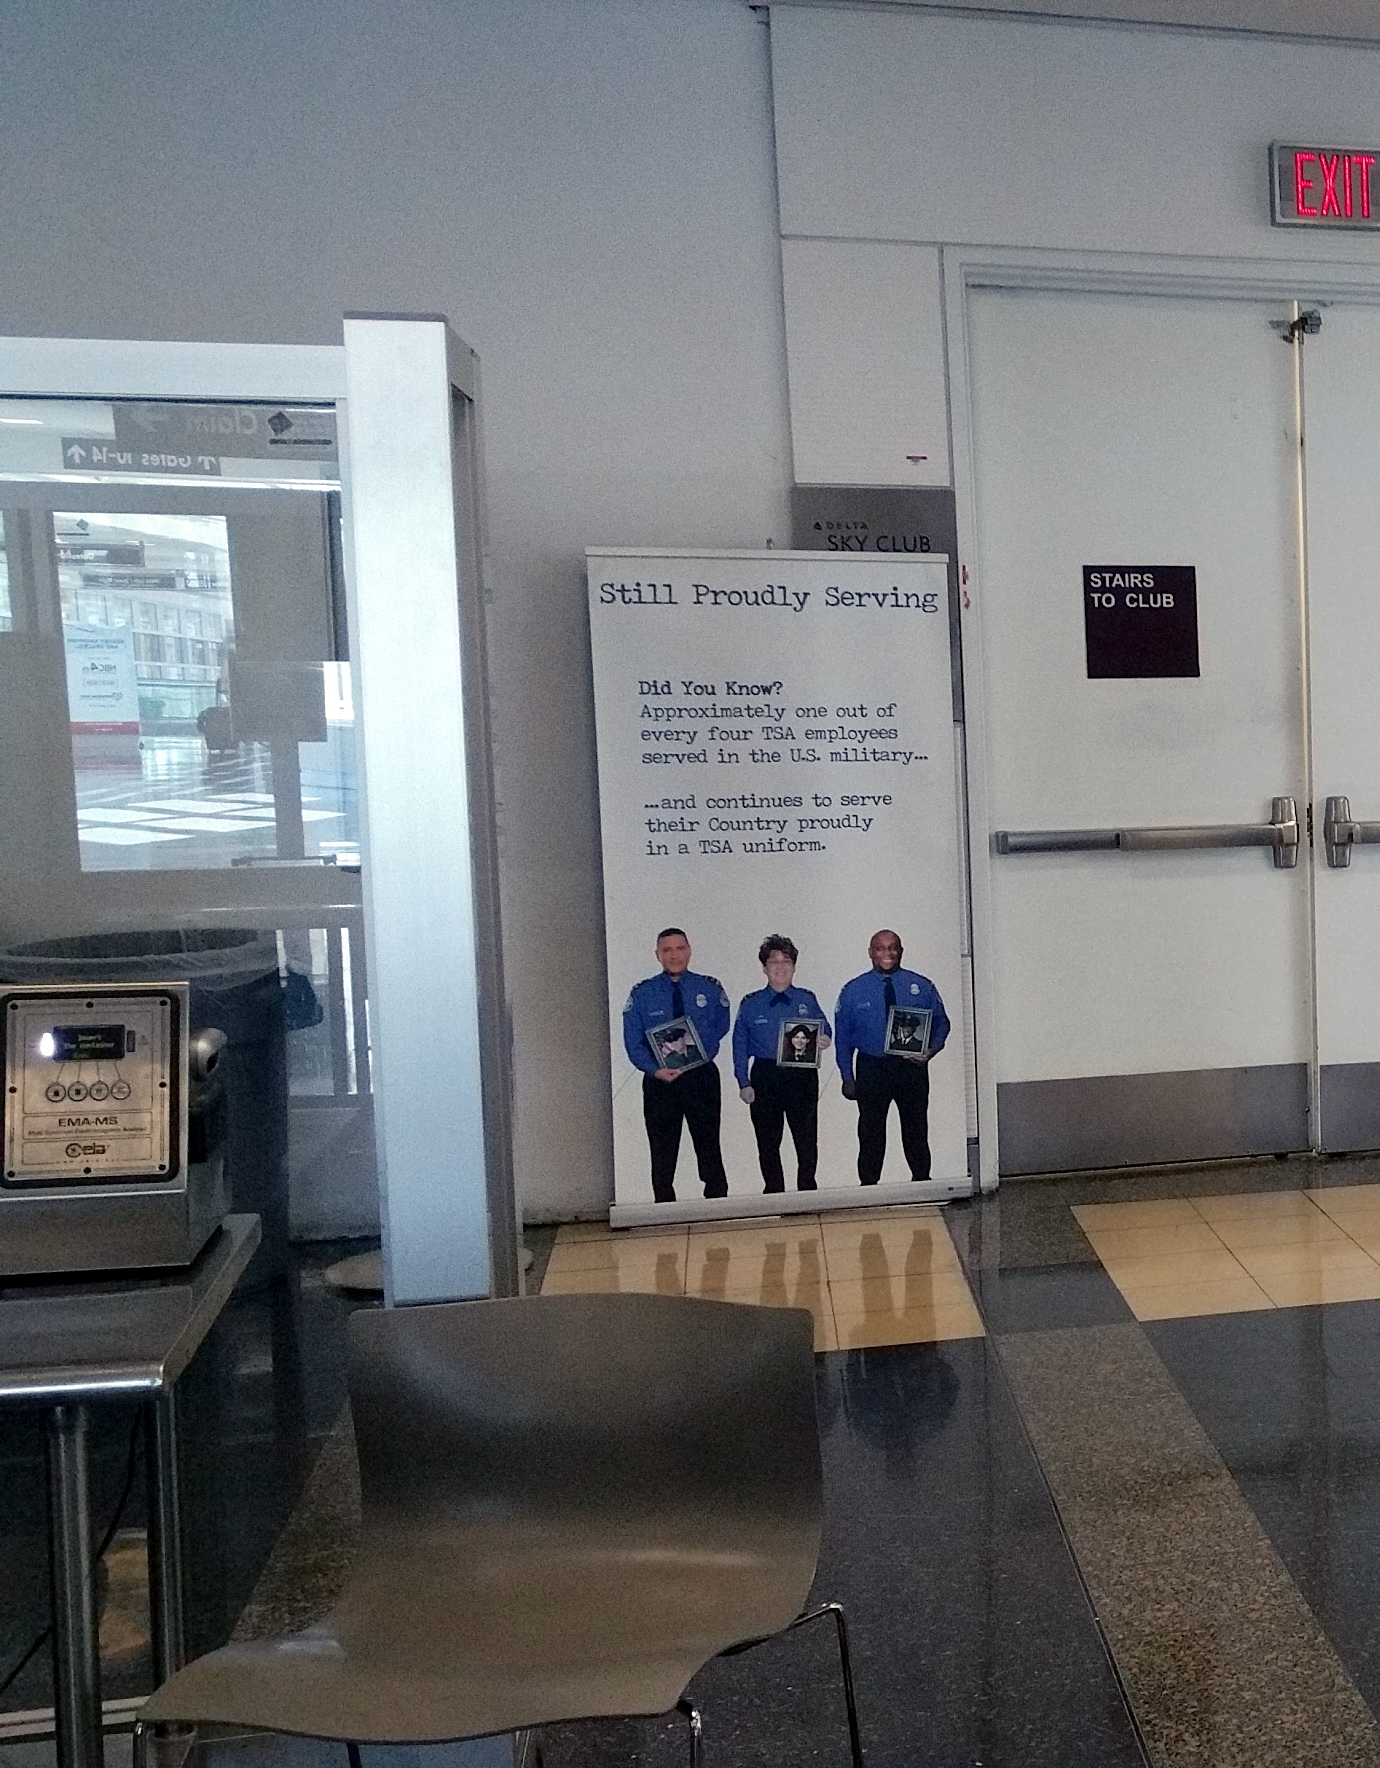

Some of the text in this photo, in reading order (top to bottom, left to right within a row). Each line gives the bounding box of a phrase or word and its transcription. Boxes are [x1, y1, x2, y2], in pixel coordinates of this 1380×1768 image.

[1295, 152, 1374, 218] EXIT
[826, 521, 869, 531] DELTA
[827, 534, 931, 552] SKY CLUB
[1090, 573, 1154, 588] STAIRS
[600, 583, 939, 613] Still Proudly Serving
[1090, 593, 1175, 608] TO CLUB
[638, 681, 783, 696] Did You Know?
[640, 703, 898, 722] Approximately one out of
[641, 726, 898, 744] every four TSA employees
[642, 748, 708, 764] served
[717, 749, 740, 764] in
[750, 749, 781, 763] the
[790, 749, 821, 763] U.S.
[706, 794, 803, 809] continues
[812, 794, 832, 808] to
[840, 794, 892, 807] serve
[645, 814, 873, 833] their Country proudly
[646, 837, 826, 856] in a TSA uniform.
[59, 1116, 118, 1127] EMA-MS
